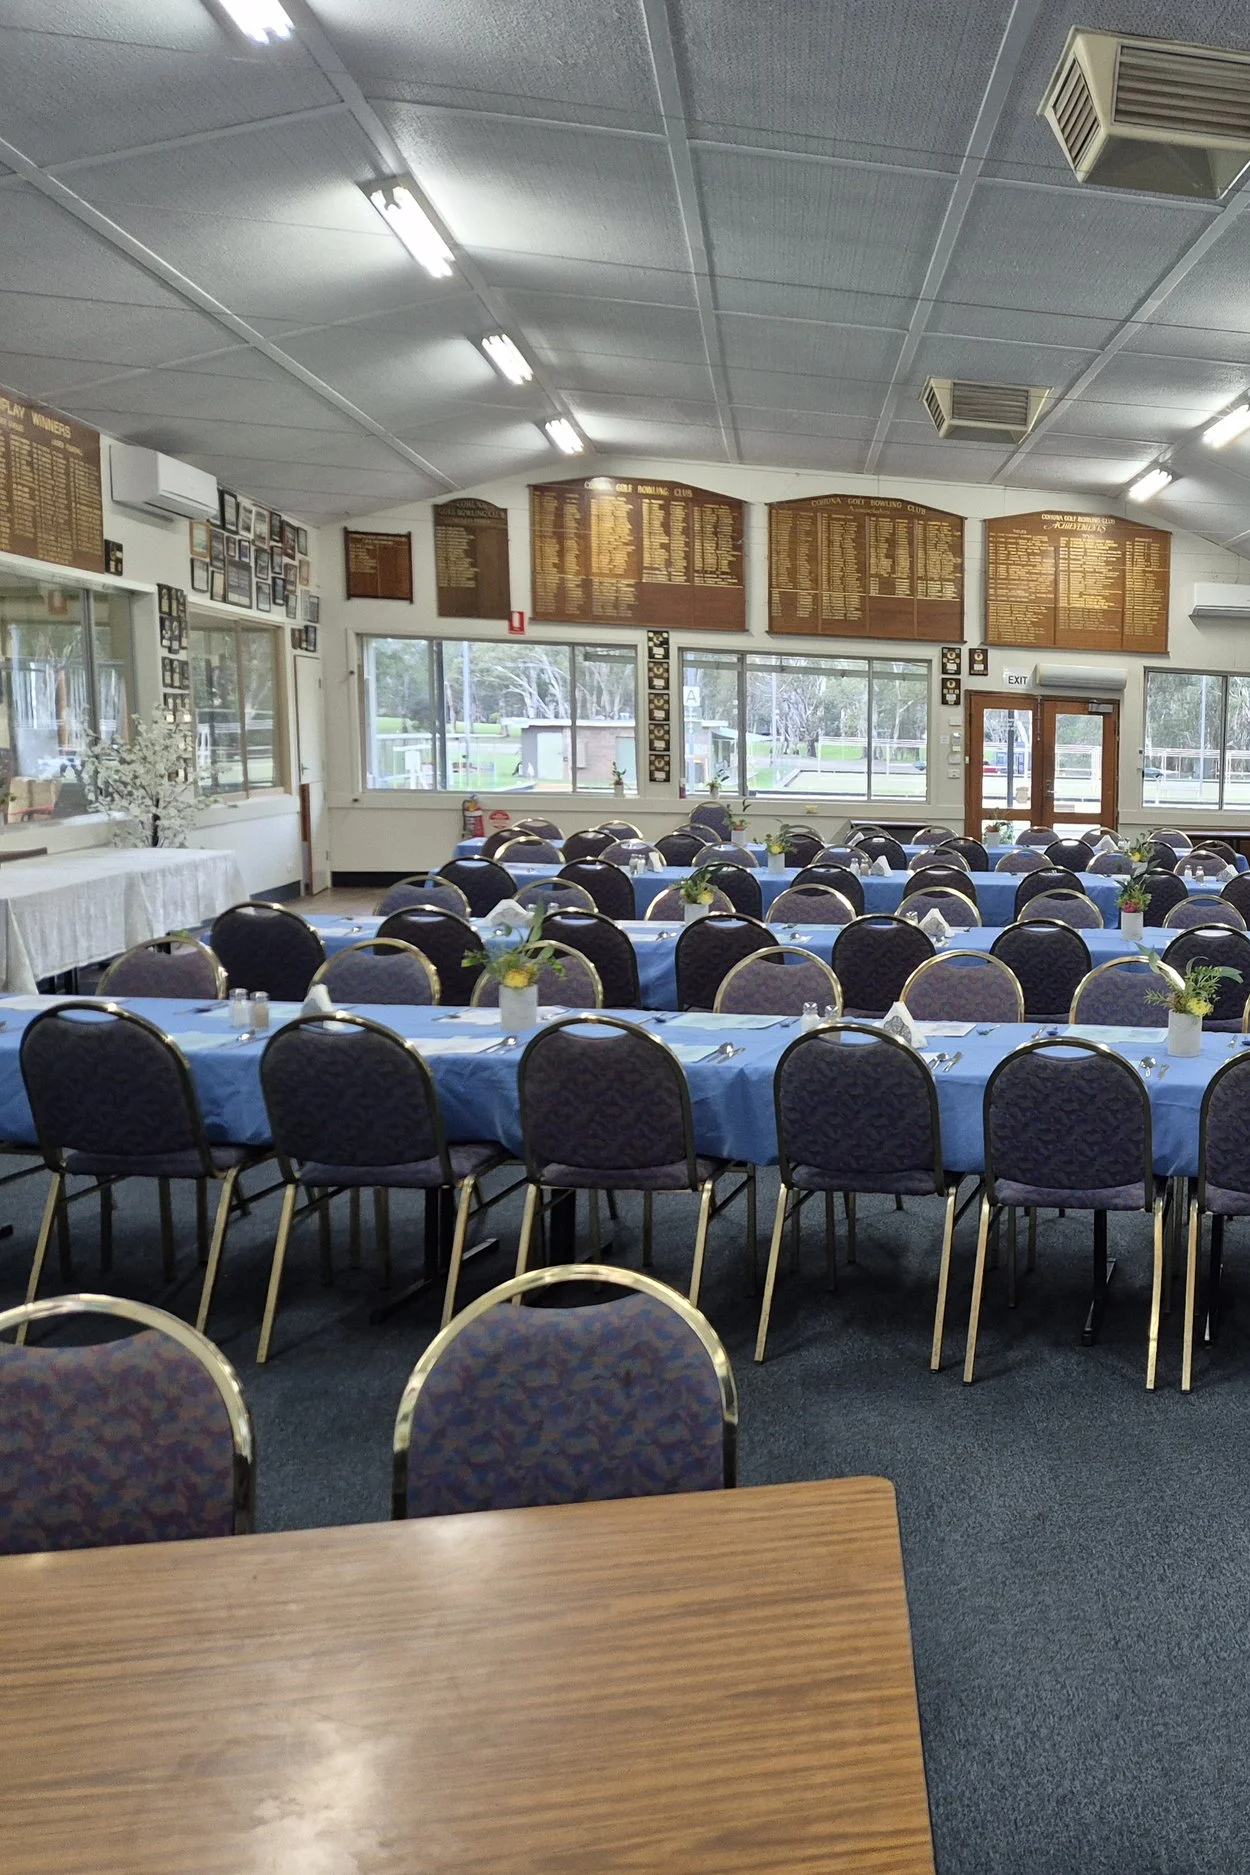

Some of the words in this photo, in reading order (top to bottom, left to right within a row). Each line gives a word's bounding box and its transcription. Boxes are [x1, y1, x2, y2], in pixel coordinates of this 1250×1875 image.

[31, 411, 72, 439] WINNERS
[615, 483, 632, 493] GOLF
[637, 485, 670, 496] BOWLING
[673, 488, 693, 498] CLUB
[870, 499, 902, 508] BOWLING
[907, 504, 926, 515] CLUB
[1078, 516, 1099, 524] BOWLING
[1008, 675, 1029, 685] EXIT
[686, 689, 698, 704] A
